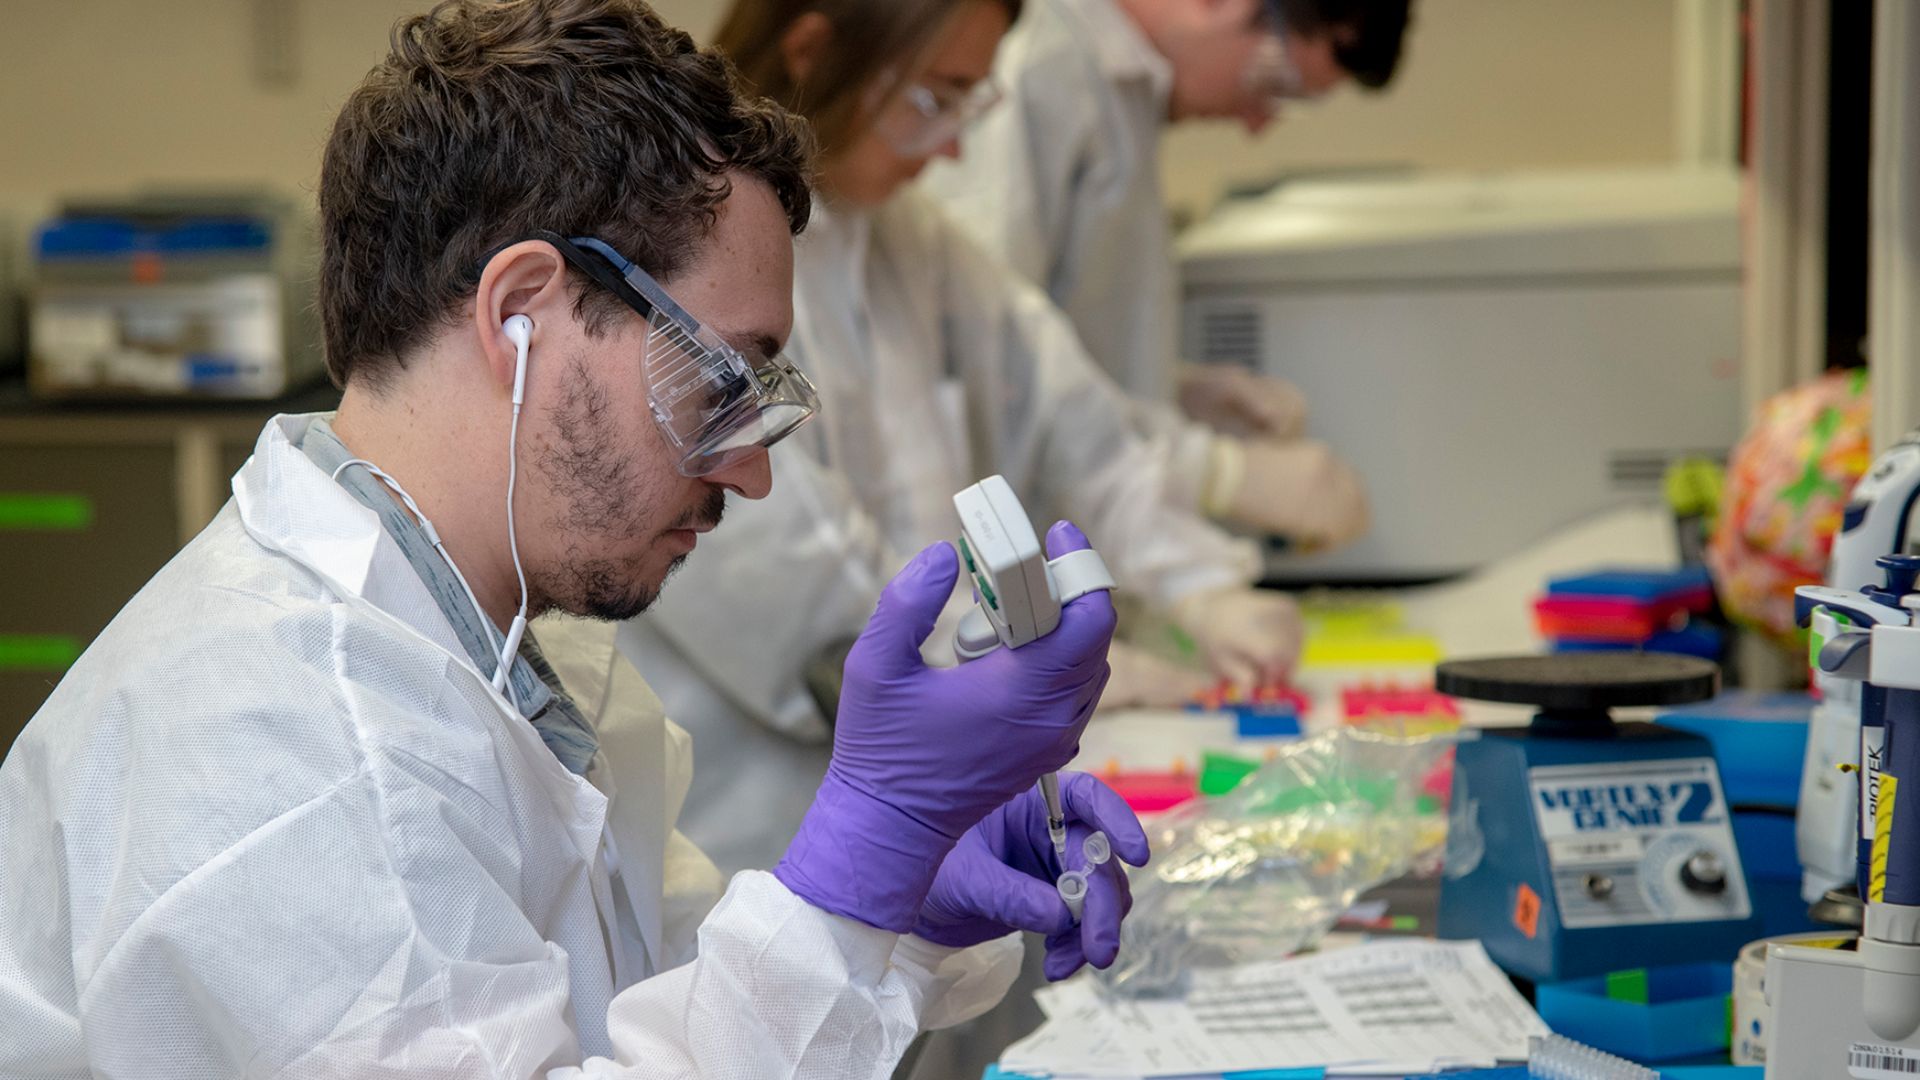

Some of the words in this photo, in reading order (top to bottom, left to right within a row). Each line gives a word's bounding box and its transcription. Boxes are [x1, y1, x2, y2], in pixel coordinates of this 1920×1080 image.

[1540, 785, 1667, 809] VORTEX
[1573, 807, 1662, 829] GENIE
[1669, 782, 1720, 823] 2
